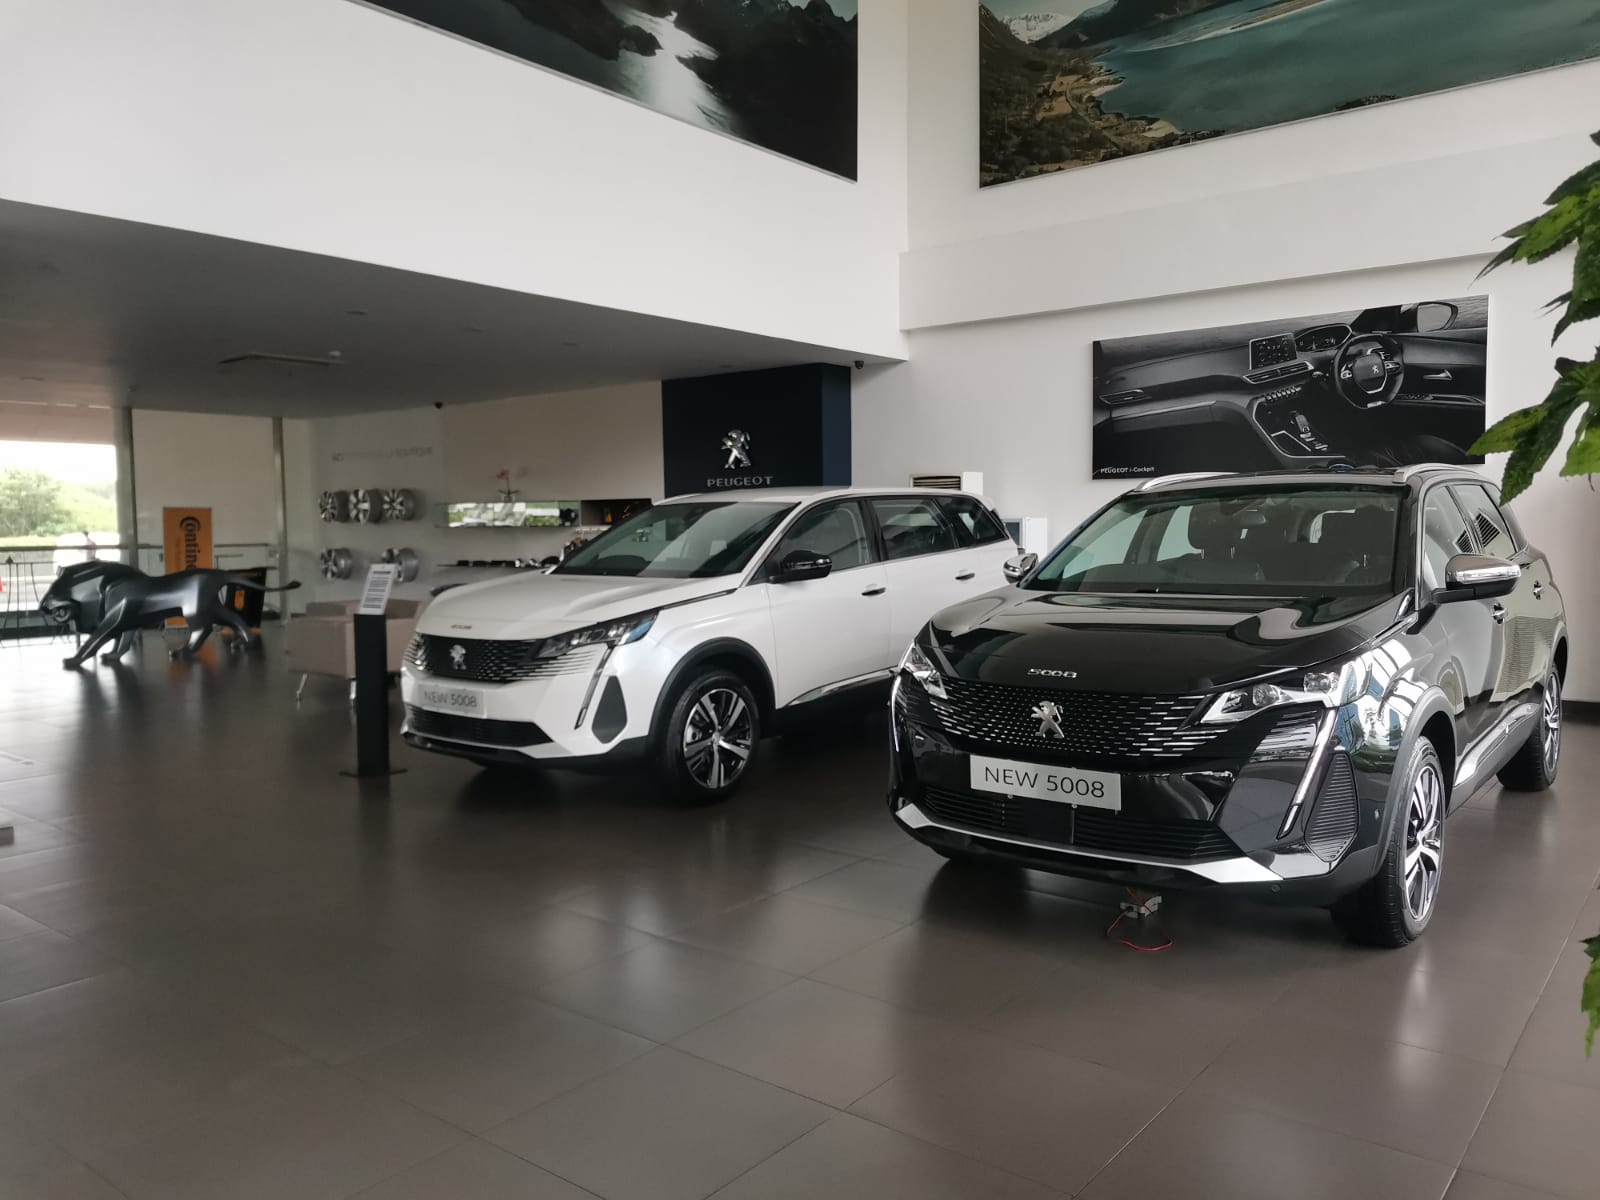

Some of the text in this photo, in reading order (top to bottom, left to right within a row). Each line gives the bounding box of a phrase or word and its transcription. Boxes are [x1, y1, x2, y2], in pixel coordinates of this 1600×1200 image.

[1100, 466, 1129, 474] PEUGEOT
[707, 476, 773, 488] PEUGEOT
[424, 691, 478, 708] NEW 5008
[985, 766, 1105, 798] NEW 5008
